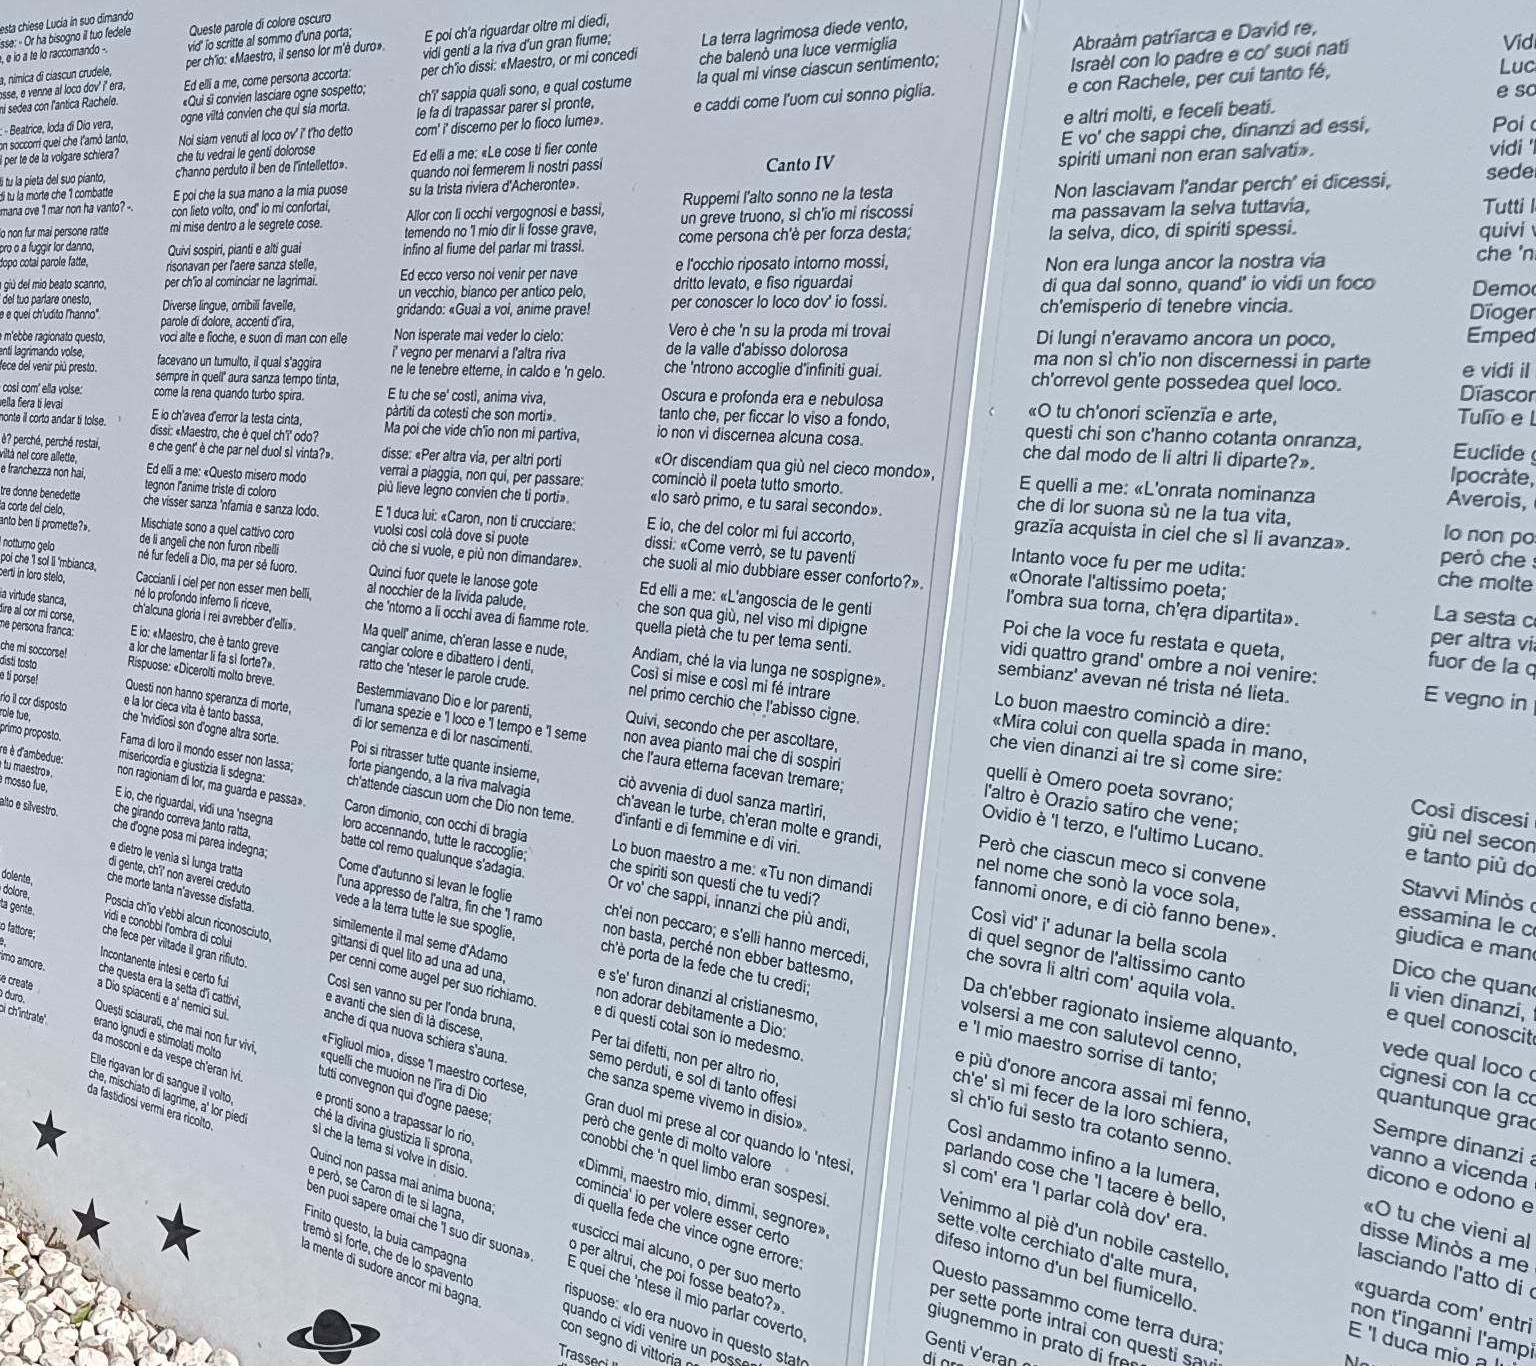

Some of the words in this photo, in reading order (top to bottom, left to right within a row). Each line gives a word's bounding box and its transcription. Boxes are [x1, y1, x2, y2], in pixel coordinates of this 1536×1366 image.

[701, 33, 718, 47] La
[721, 32, 751, 46] terra
[754, 26, 820, 45] lagrimosa
[823, 20, 862, 37] diede
[766, 158, 811, 173] Canto
[815, 155, 836, 171] IV
[683, 190, 741, 209] Ruppemi
[743, 190, 774, 204] l'alto
[776, 191, 819, 204] sonno
[821, 190, 840, 202] ne
[843, 186, 856, 201] la
[859, 186, 893, 200] testa
[1045, 256, 1079, 272] Non
[1083, 259, 1110, 272] era
[1114, 255, 1160, 275] lunga
[1165, 257, 1215, 271] ancor
[1218, 253, 1234, 270] la
[1239, 254, 1295, 270] nostra
[1300, 252, 1326, 269] via
[394, 328, 416, 341] Non
[418, 328, 461, 345] isperate
[463, 329, 484, 342] mai
[486, 329, 519, 342] veder
[520, 328, 532, 342] lo
[661, 387, 706, 403] Oscura
[709, 392, 718, 403] e
[721, 389, 779, 407] profonda
[782, 394, 805, 406] era
[808, 394, 817, 406] e
[820, 392, 884, 408] nebulosa
[1020, 475, 1032, 491] E
[1035, 477, 1079, 495] quelli
[1082, 481, 1093, 494] a
[1134, 480, 1212, 499] «L'onrata
[1218, 485, 1316, 504] nominanza
[304, 1203, 332, 1223] Finito
[373, 1226, 383, 1240] la
[385, 1229, 408, 1249] buia
[411, 1241, 467, 1268] campagna
[925, 1330, 967, 1355] Genti
